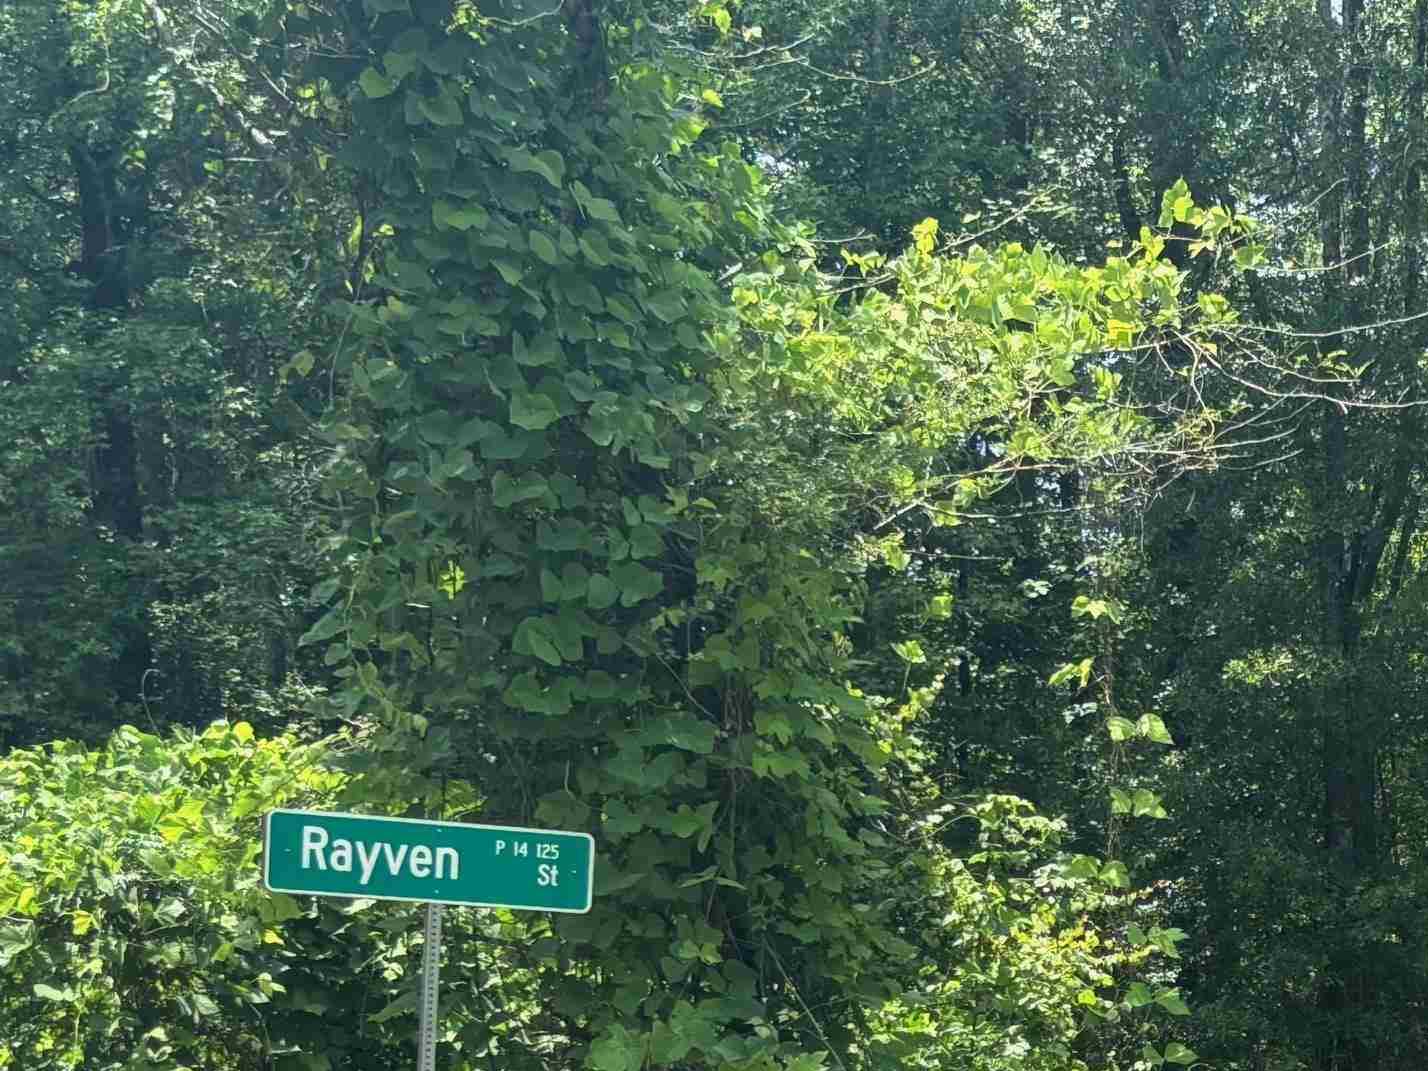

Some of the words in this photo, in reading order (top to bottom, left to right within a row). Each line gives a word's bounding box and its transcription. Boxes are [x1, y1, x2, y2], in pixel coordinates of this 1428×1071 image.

[302, 826, 459, 884] Rayven
[495, 840, 505, 855] P
[513, 841, 529, 857] 14
[536, 843, 560, 860] 125
[537, 863, 559, 887] St
